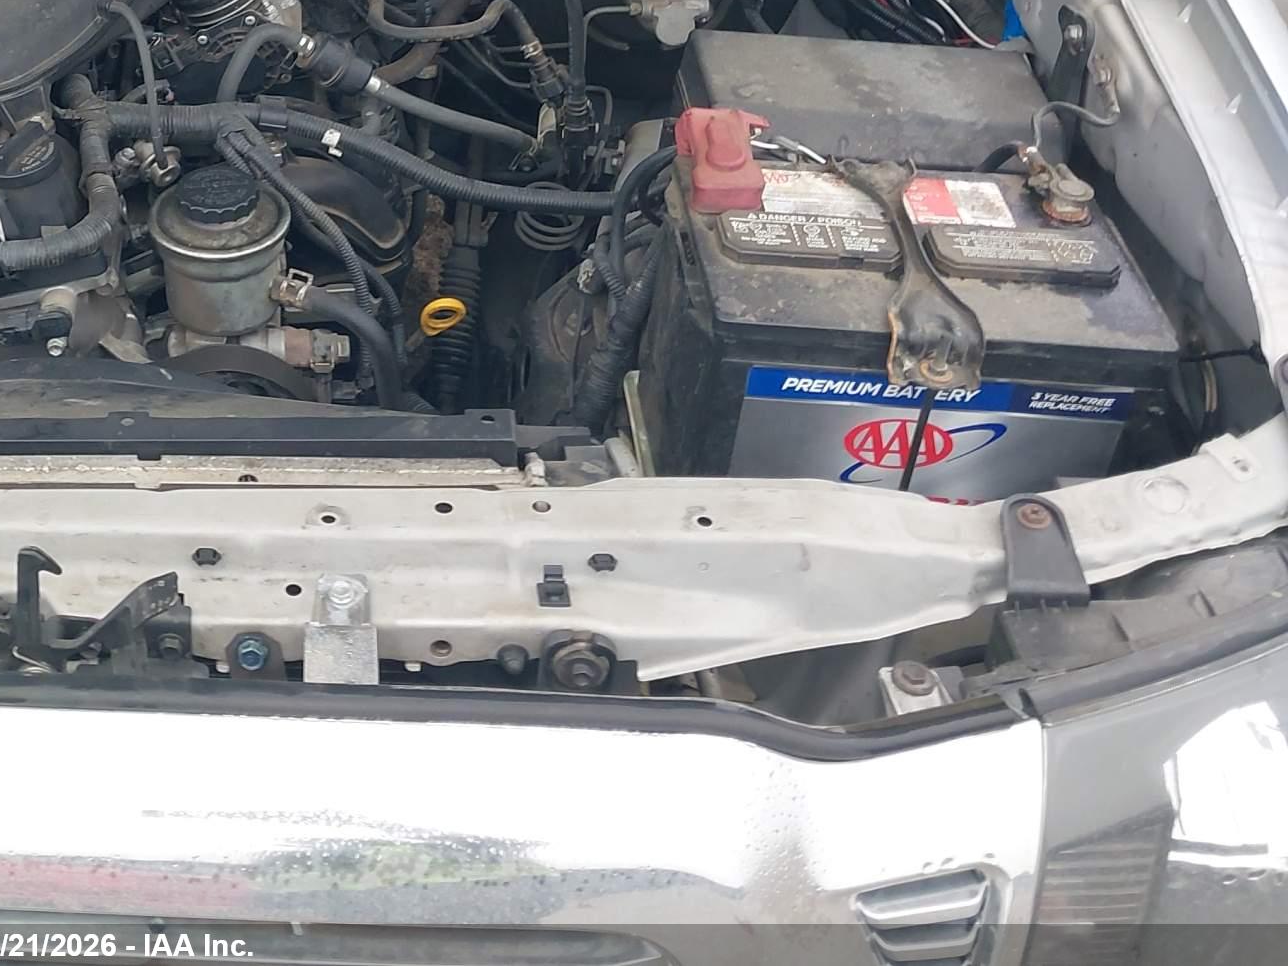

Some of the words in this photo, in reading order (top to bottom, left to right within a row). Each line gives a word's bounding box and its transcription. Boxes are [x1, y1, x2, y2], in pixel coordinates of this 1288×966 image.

[759, 213, 805, 223] DANGER
[781, 377, 882, 396] PREMIUM
[882, 385, 981, 403] BATERY
[1028, 401, 1111, 413] REPLACEMENT
[1031, 392, 1043, 400] 3
[1043, 393, 1078, 403] YEAR
[1078, 396, 1116, 407] FREE
[850, 420, 948, 467] AAA
